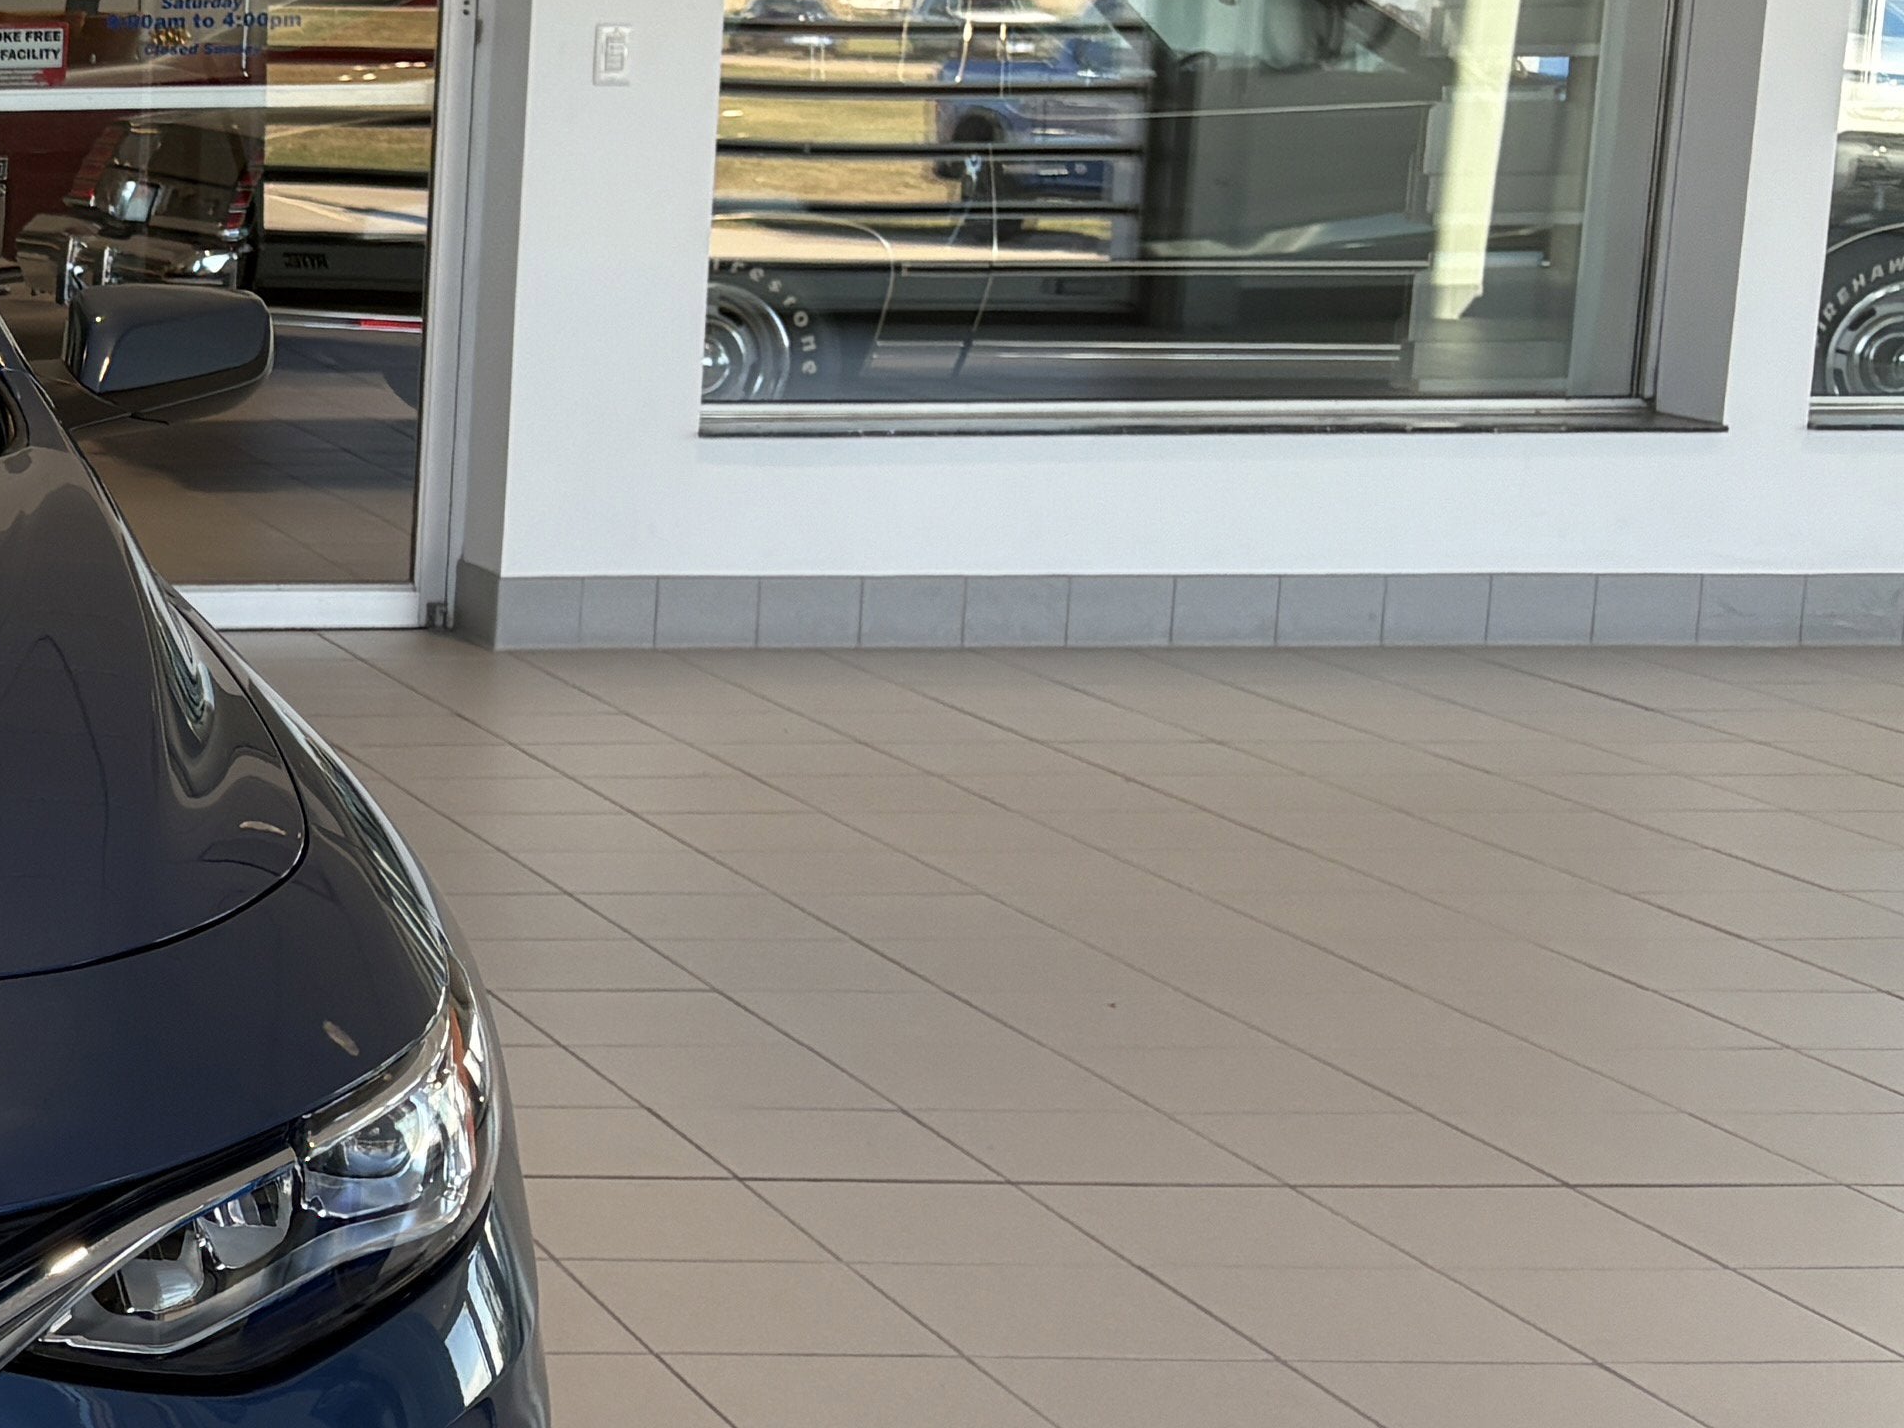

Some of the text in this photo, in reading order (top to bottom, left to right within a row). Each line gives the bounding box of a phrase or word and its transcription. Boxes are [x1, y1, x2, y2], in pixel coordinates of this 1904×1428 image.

[192, 12, 214, 29] to
[222, 11, 302, 29] 4:00pm
[25, 30, 61, 42] FREE
[0, 48, 61, 60] FACILITY
[144, 43, 198, 57] Closed
[1818, 255, 1904, 332] IREHAW
[712, 256, 818, 375] irestone
